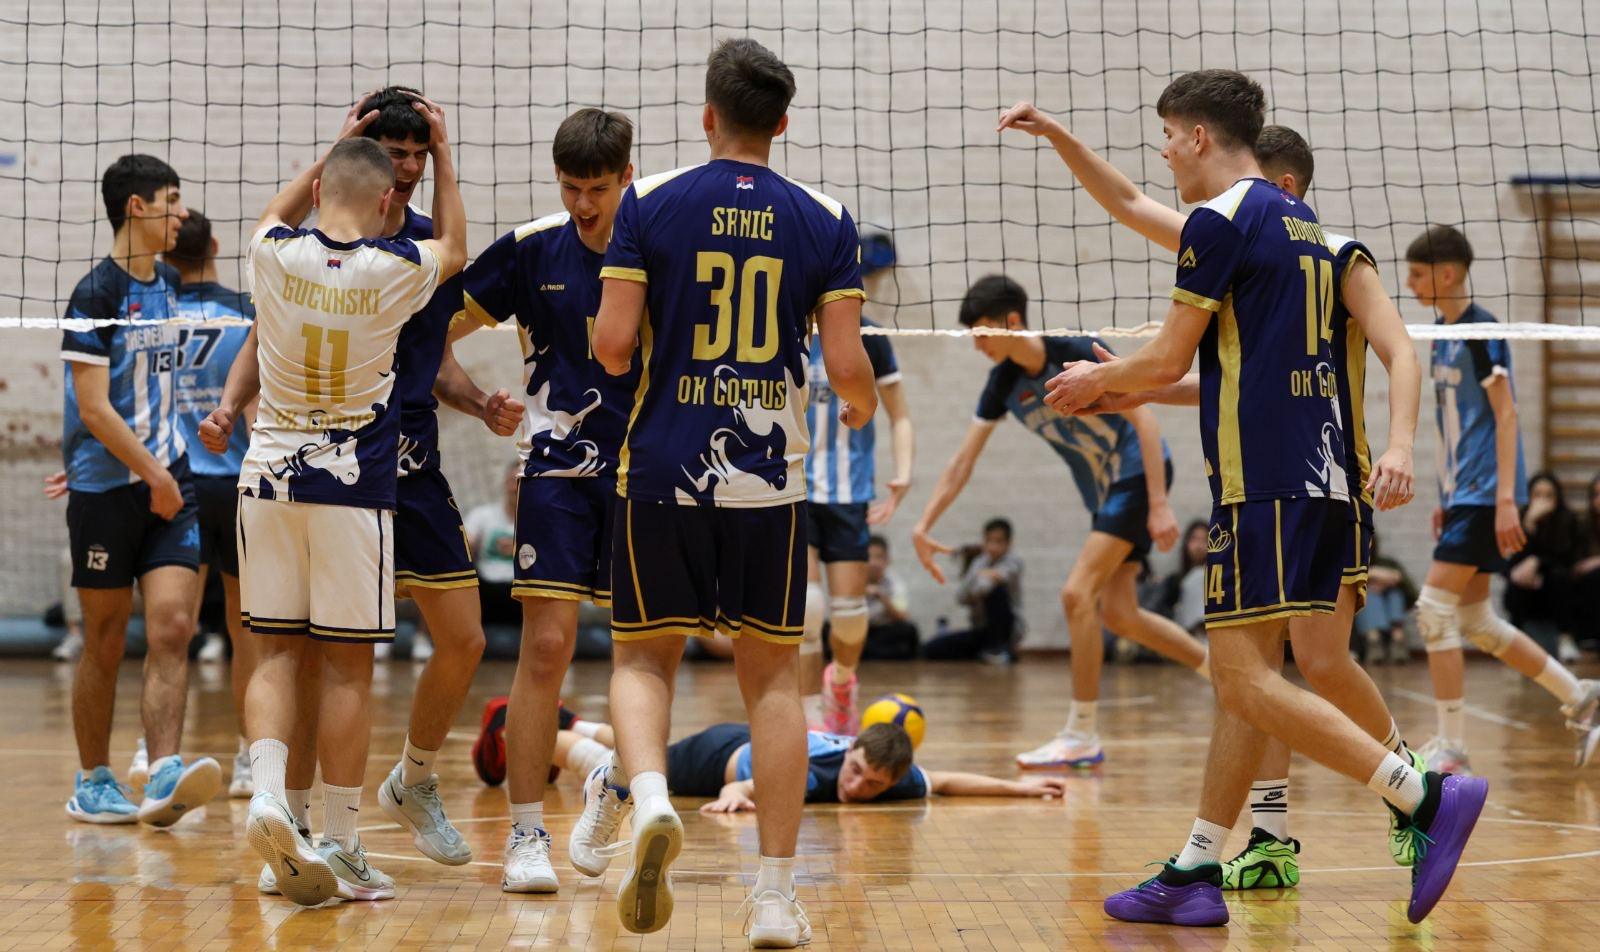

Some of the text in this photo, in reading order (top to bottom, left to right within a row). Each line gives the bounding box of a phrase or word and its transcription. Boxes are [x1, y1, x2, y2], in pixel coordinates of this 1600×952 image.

[711, 205, 774, 241] SRNIĆ
[692, 251, 783, 364] 30
[1298, 255, 1334, 355] 14
[301, 322, 349, 404] 11
[676, 375, 786, 410] OK LOTUS
[1290, 370, 1313, 397] OK
[87, 550, 109, 570] 13
